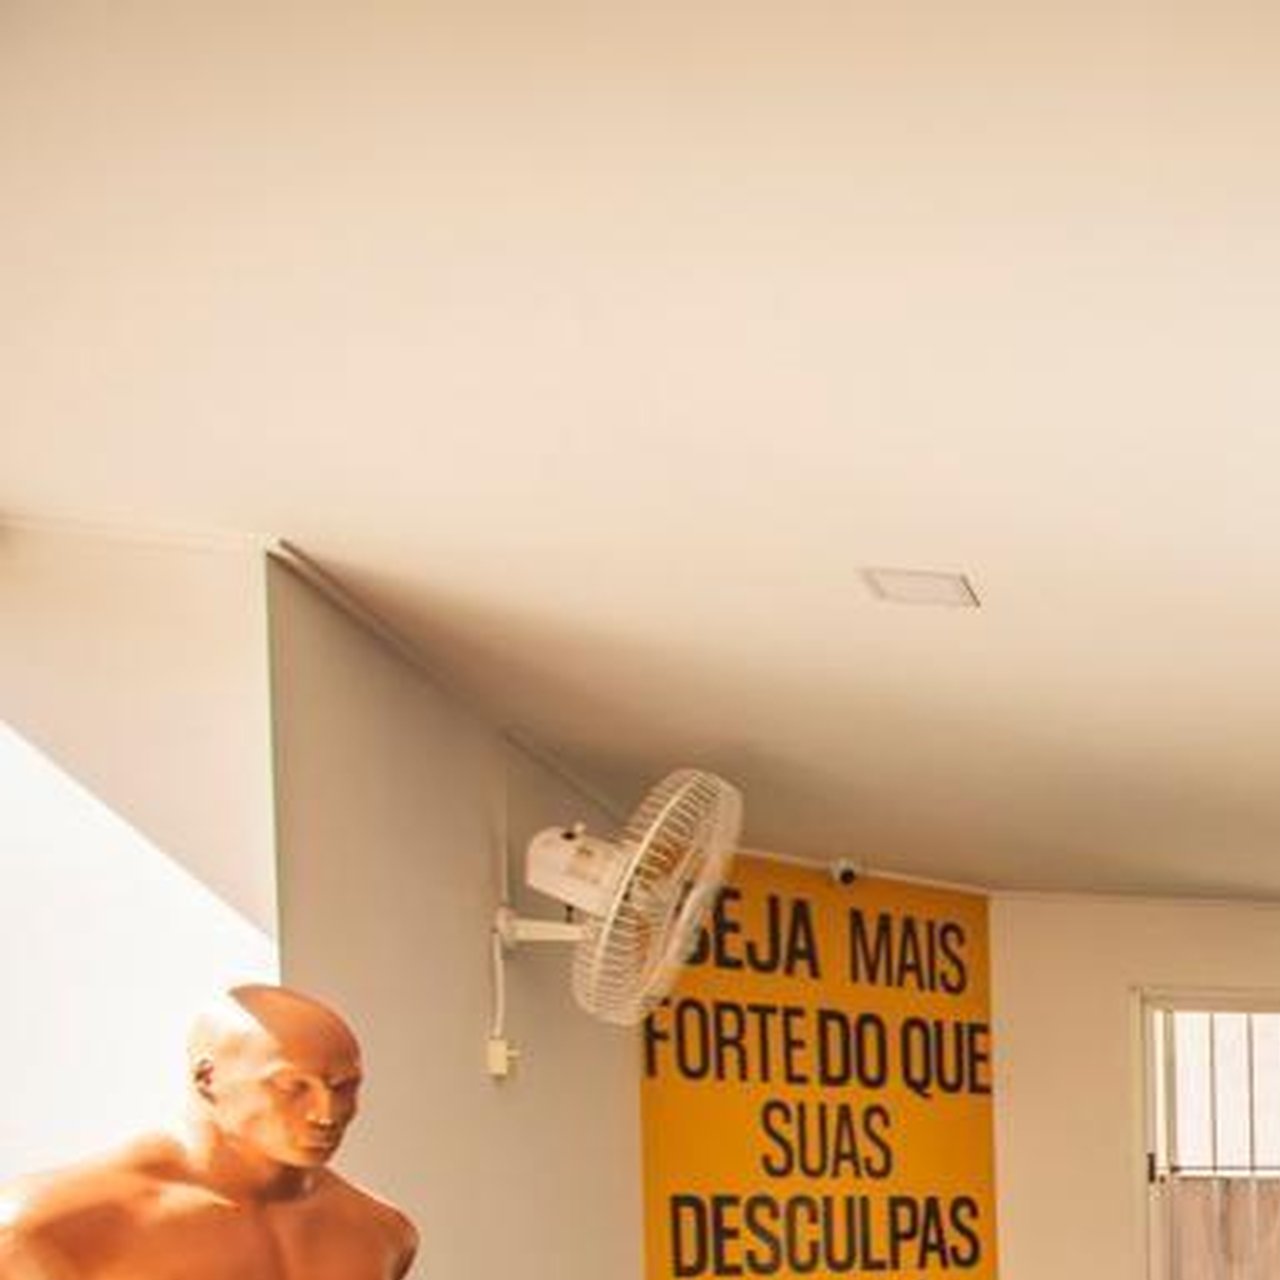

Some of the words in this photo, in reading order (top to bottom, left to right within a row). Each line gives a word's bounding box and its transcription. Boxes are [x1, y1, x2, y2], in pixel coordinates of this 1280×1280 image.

[849, 908, 968, 995] MAIS
[643, 997, 808, 1084] FORTE
[818, 1008, 888, 1088] DO
[900, 1016, 991, 1098] QUE
[760, 1099, 894, 1180] SUAS
[669, 1193, 981, 1279] DESCULPAS
